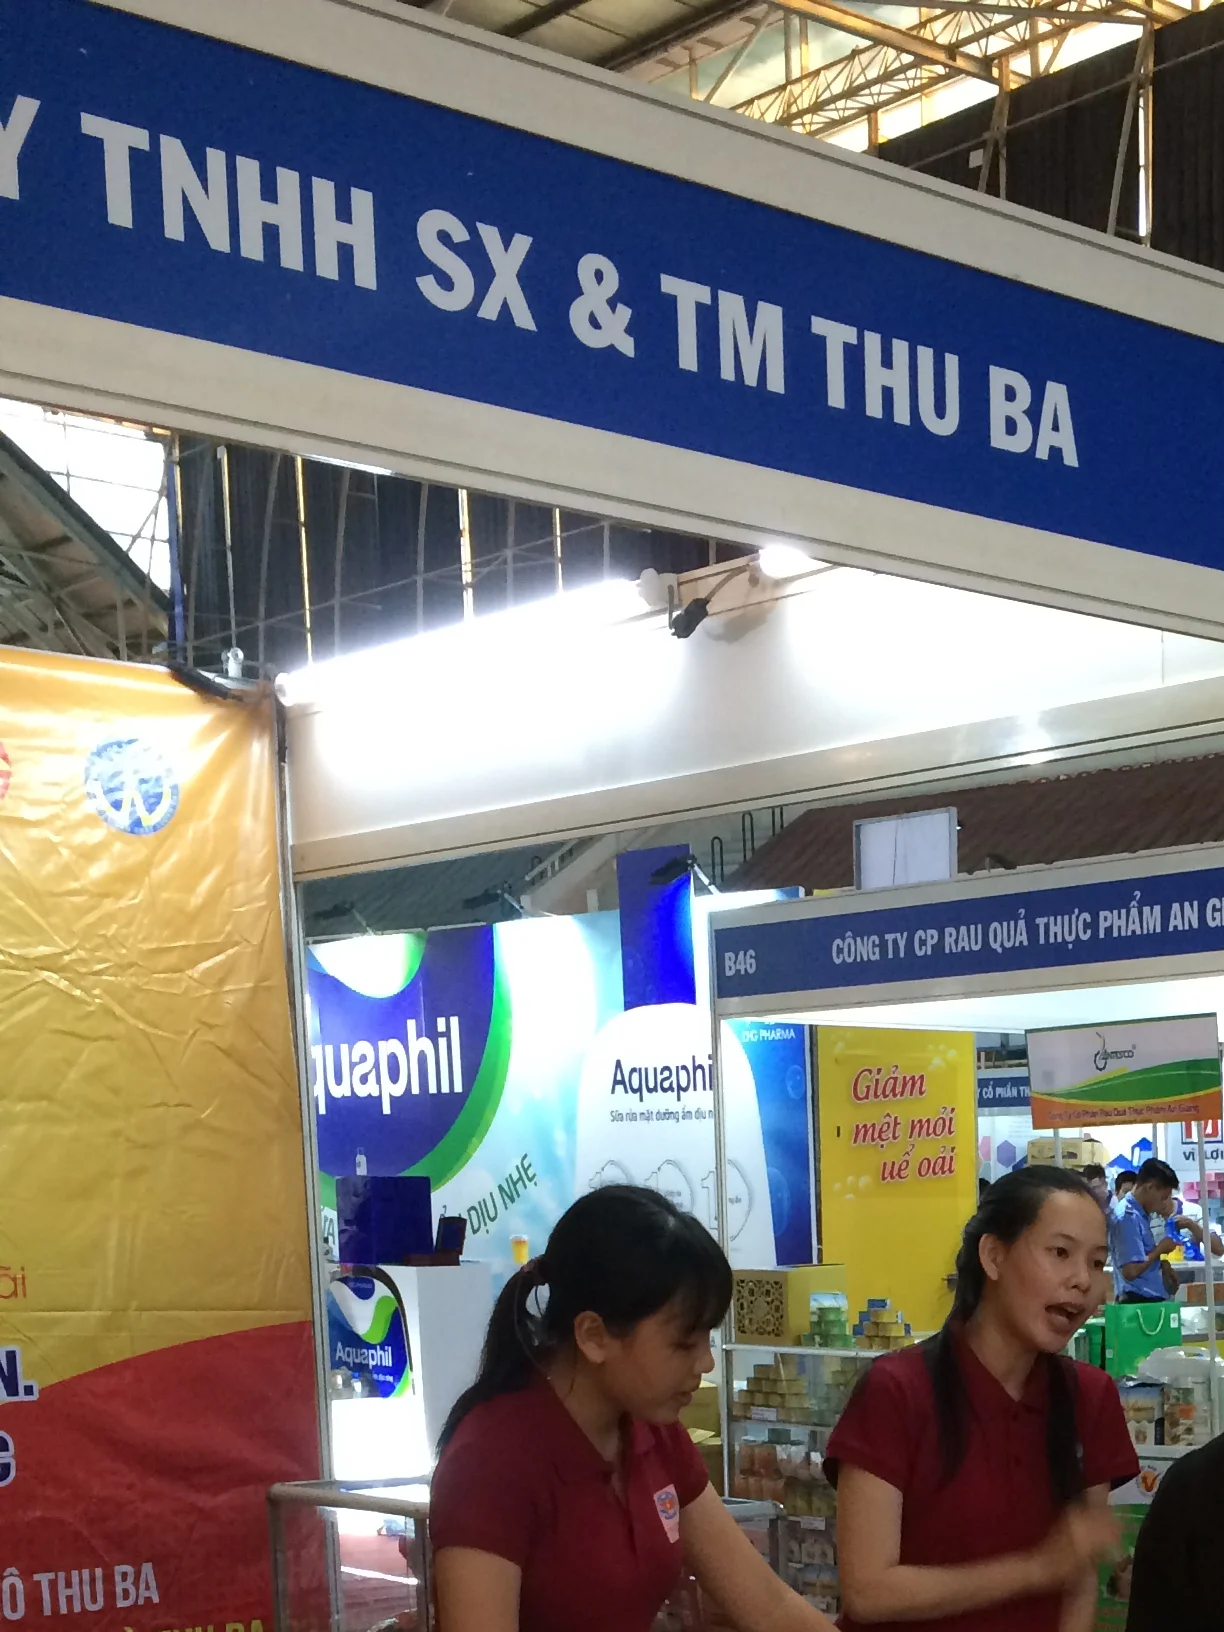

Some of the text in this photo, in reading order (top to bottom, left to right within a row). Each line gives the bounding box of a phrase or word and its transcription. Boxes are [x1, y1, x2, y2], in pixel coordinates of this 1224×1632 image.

[81, 112, 377, 290] TNHH
[416, 209, 538, 332] SX
[569, 253, 635, 358] &
[661, 273, 785, 394] TM
[811, 315, 961, 436] THU
[989, 365, 1079, 468] BA
[832, 931, 880, 965] CÔNG
[885, 932, 908, 959] TY
[914, 929, 939, 957] CP
[944, 924, 982, 954] RAU
[989, 908, 1028, 954] QUẢ
[1035, 908, 1092, 949] THỰC
[1098, 890, 1162, 939] PHẨM
[1168, 900, 1199, 932] AN
[725, 949, 757, 977] B46
[760, 1028, 796, 1041] PHARMA
[311, 1016, 463, 1115] quaphil
[610, 1054, 713, 1103] Aquaphi
[851, 1063, 927, 1104] Giảm
[852, 1104, 957, 1149] mệt mỏi
[880, 1145, 957, 1183] uể oải
[335, 1341, 392, 1370] Aquaphil
[33, 1567, 104, 1617] THU
[115, 1562, 160, 1609] BA
